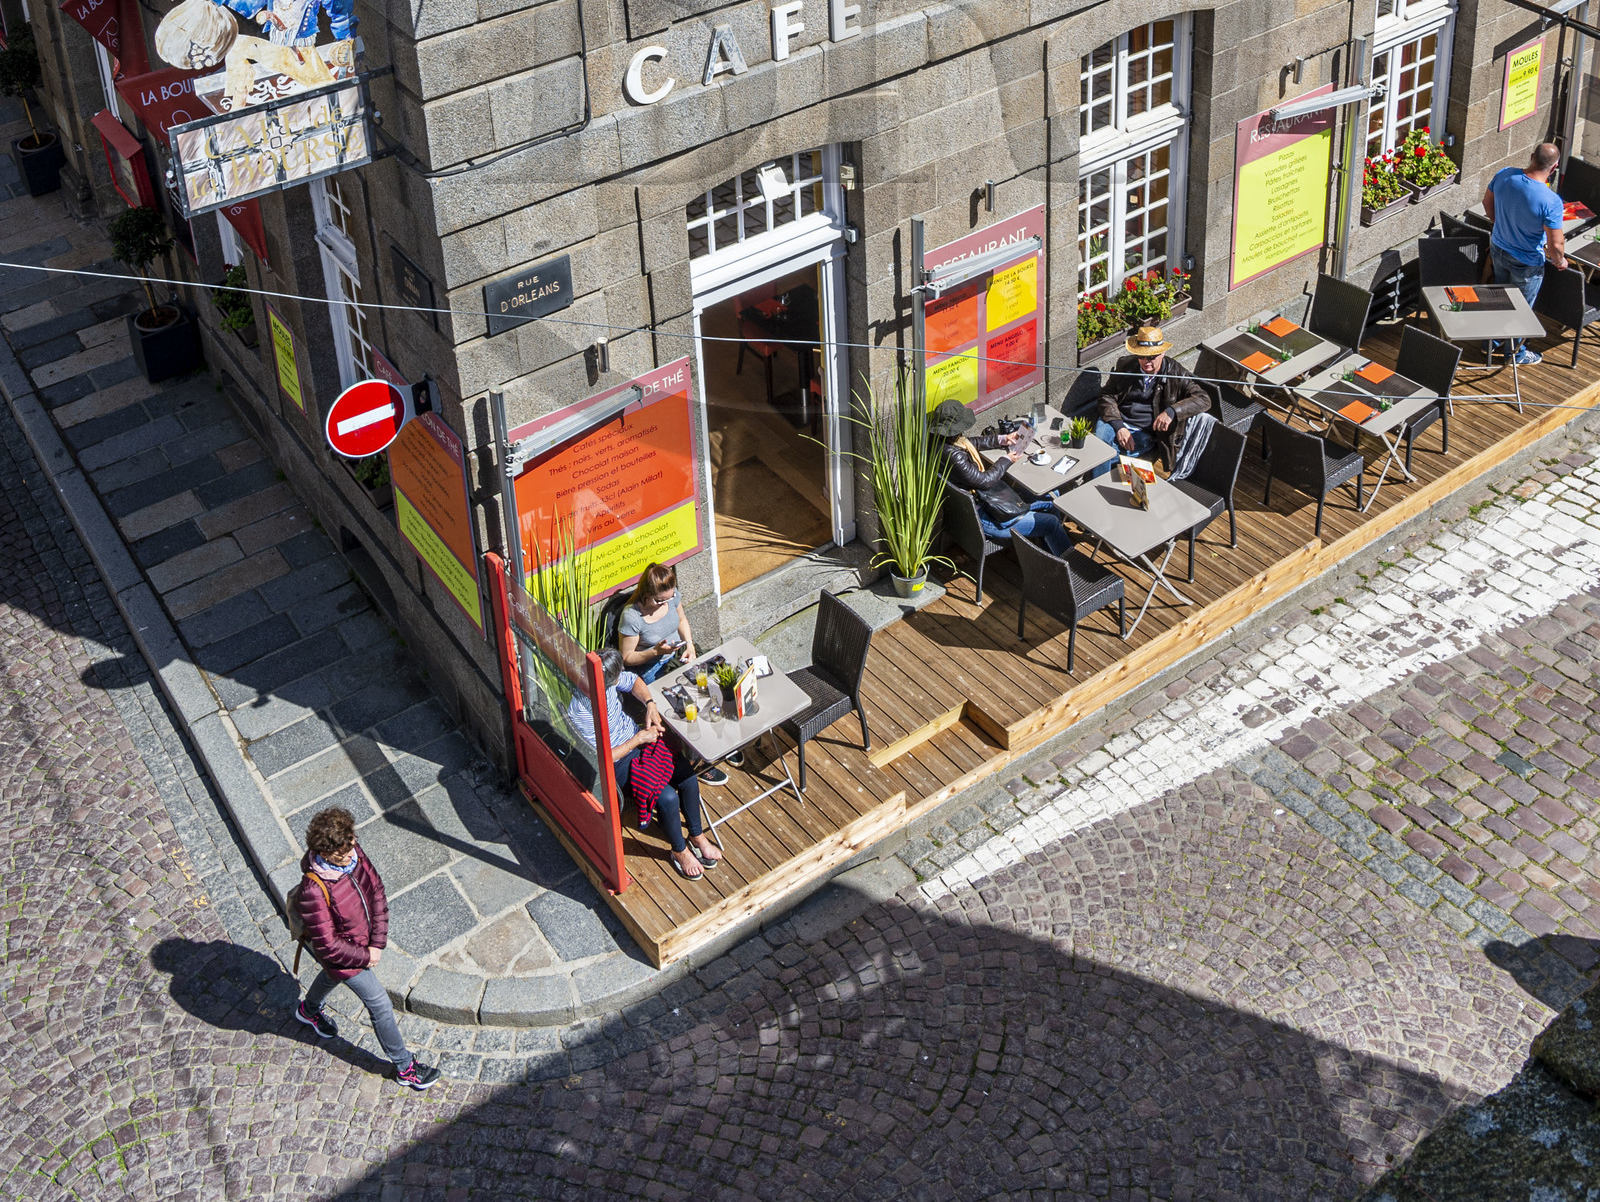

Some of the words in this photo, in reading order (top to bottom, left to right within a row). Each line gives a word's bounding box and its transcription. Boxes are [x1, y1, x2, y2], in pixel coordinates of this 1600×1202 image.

[77, 5, 90, 20] LA
[1512, 50, 1539, 69] MOULES
[141, 90, 158, 106] LA
[314, 105, 344, 129] de
[191, 170, 218, 199] la
[230, 124, 363, 188] BOURSE
[1278, 148, 1294, 163] Pizzas
[1264, 162, 1286, 178] Viandes
[517, 275, 540, 290] RUE
[990, 338, 1003, 349] MENU
[933, 364, 948, 375] MENU
[643, 379, 660, 397] DE
[662, 367, 684, 389] THÉ
[573, 437, 596, 454] Cafés
[597, 421, 634, 445] spéciaux
[549, 462, 567, 477] Thés
[616, 422, 658, 448] aromatisés
[571, 456, 609, 480] Chocolat
[611, 444, 638, 463] maison
[556, 483, 575, 499] Bière
[577, 469, 609, 491] pression
[620, 448, 656, 471] bouteilles
[617, 480, 638, 498] (Alain
[640, 469, 663, 487] Millat)
[596, 477, 619, 494] Sodas
[595, 499, 625, 519] Apéritifs
[586, 521, 602, 535] Vins
[604, 516, 614, 527] au
[622, 537, 633, 549] au
[633, 521, 668, 544] chocolat
[621, 543, 649, 563] Kouign
[649, 529, 676, 548] Amann
[599, 566, 618, 583] chez
[619, 553, 648, 573] Timothy
[655, 538, 681, 556] Glaces
